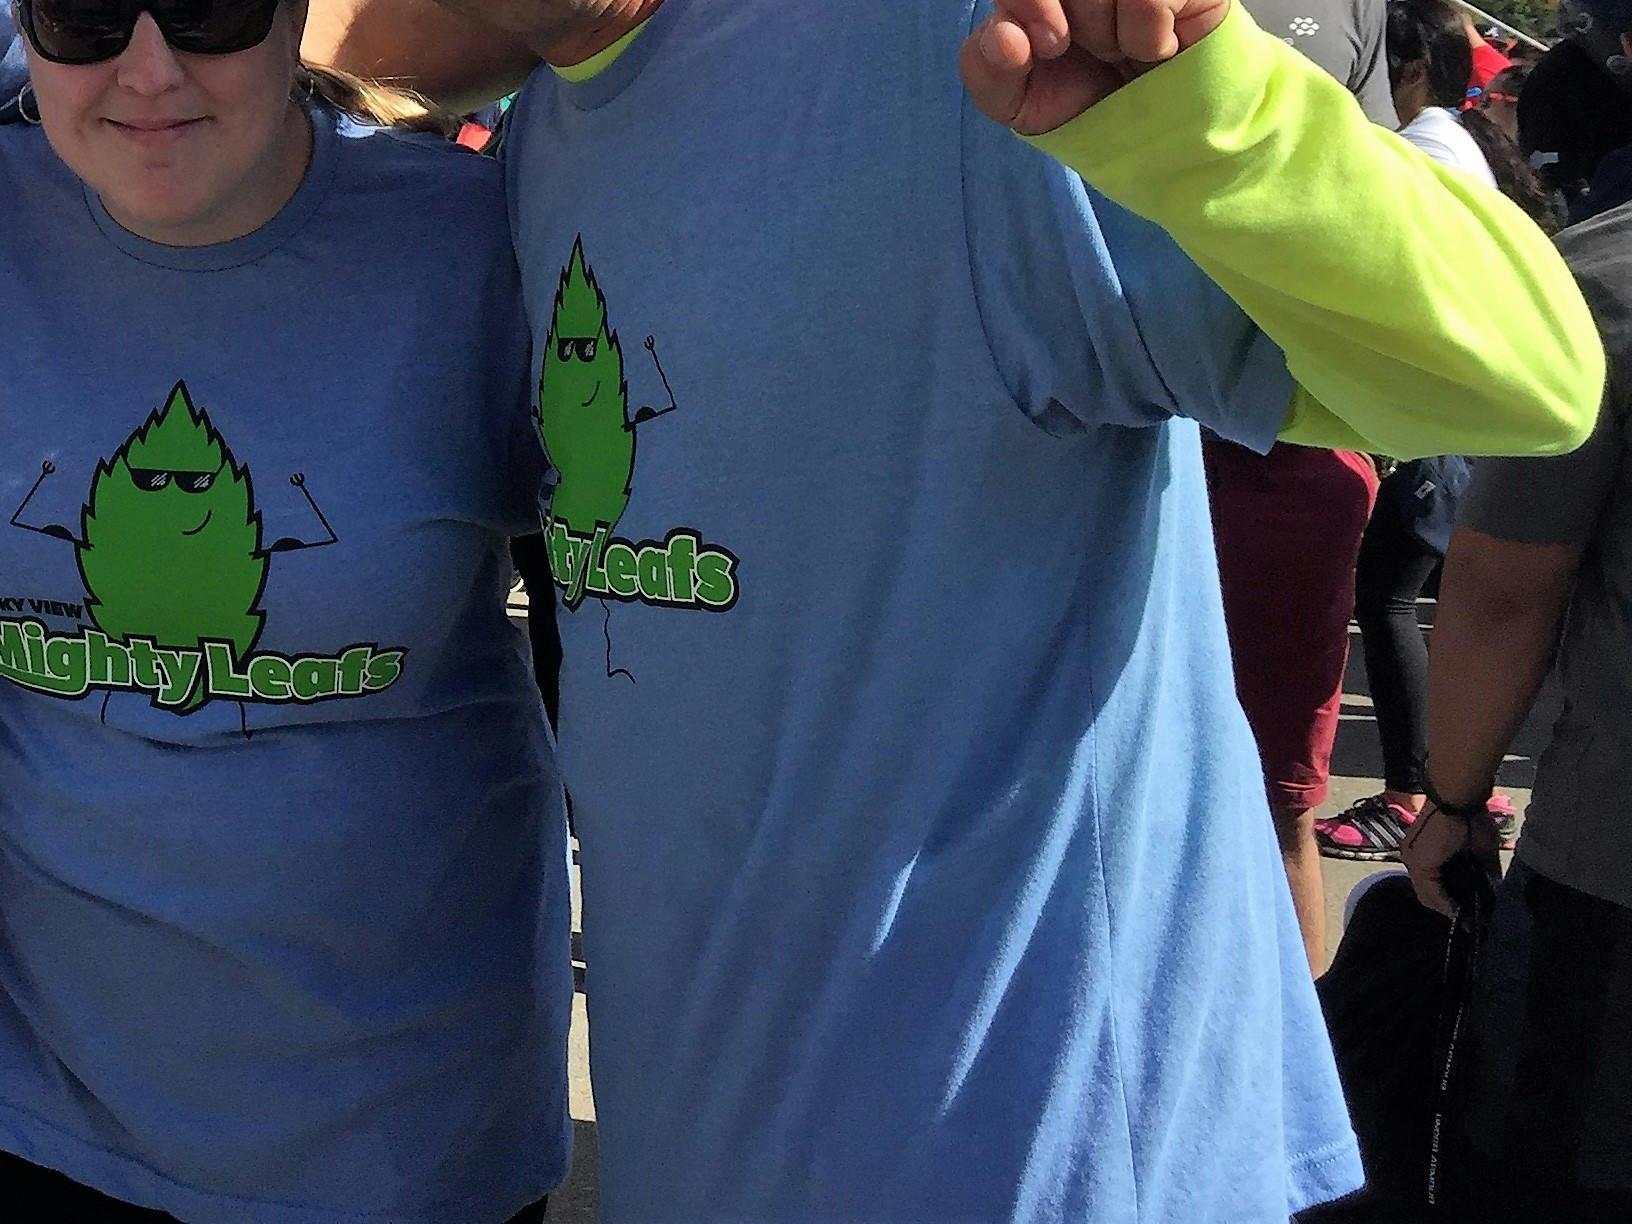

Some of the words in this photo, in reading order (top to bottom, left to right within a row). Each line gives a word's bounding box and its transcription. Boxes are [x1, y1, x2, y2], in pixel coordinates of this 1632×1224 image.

[585, 526, 735, 606] Leafs
[27, 598, 83, 619] VIEW
[203, 641, 404, 700] Leafs
